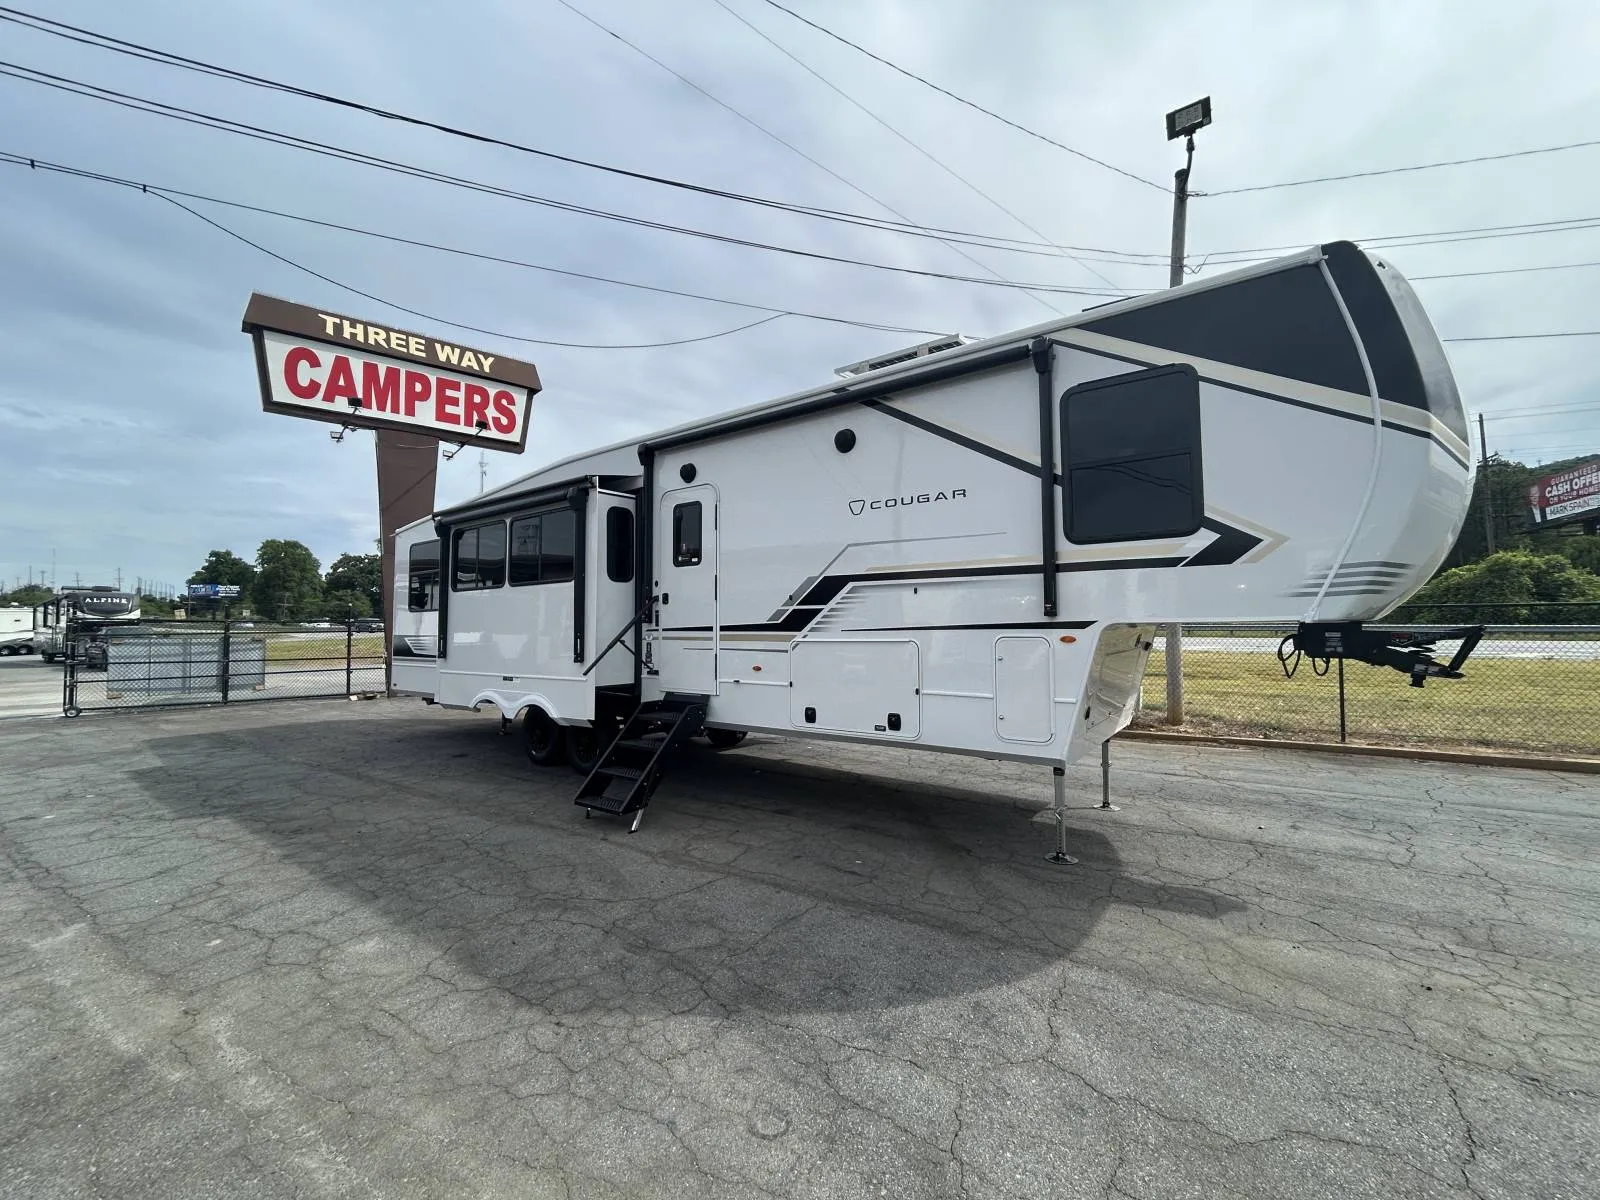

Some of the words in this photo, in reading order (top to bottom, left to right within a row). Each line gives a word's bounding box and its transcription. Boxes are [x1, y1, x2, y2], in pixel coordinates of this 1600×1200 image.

[318, 313, 427, 358] THREE
[434, 342, 495, 373] WAY
[283, 346, 517, 435] CAMPERS
[870, 489, 967, 509] COUGAR
[1545, 481, 1570, 497] CASH
[1572, 471, 1600, 490] OFFE
